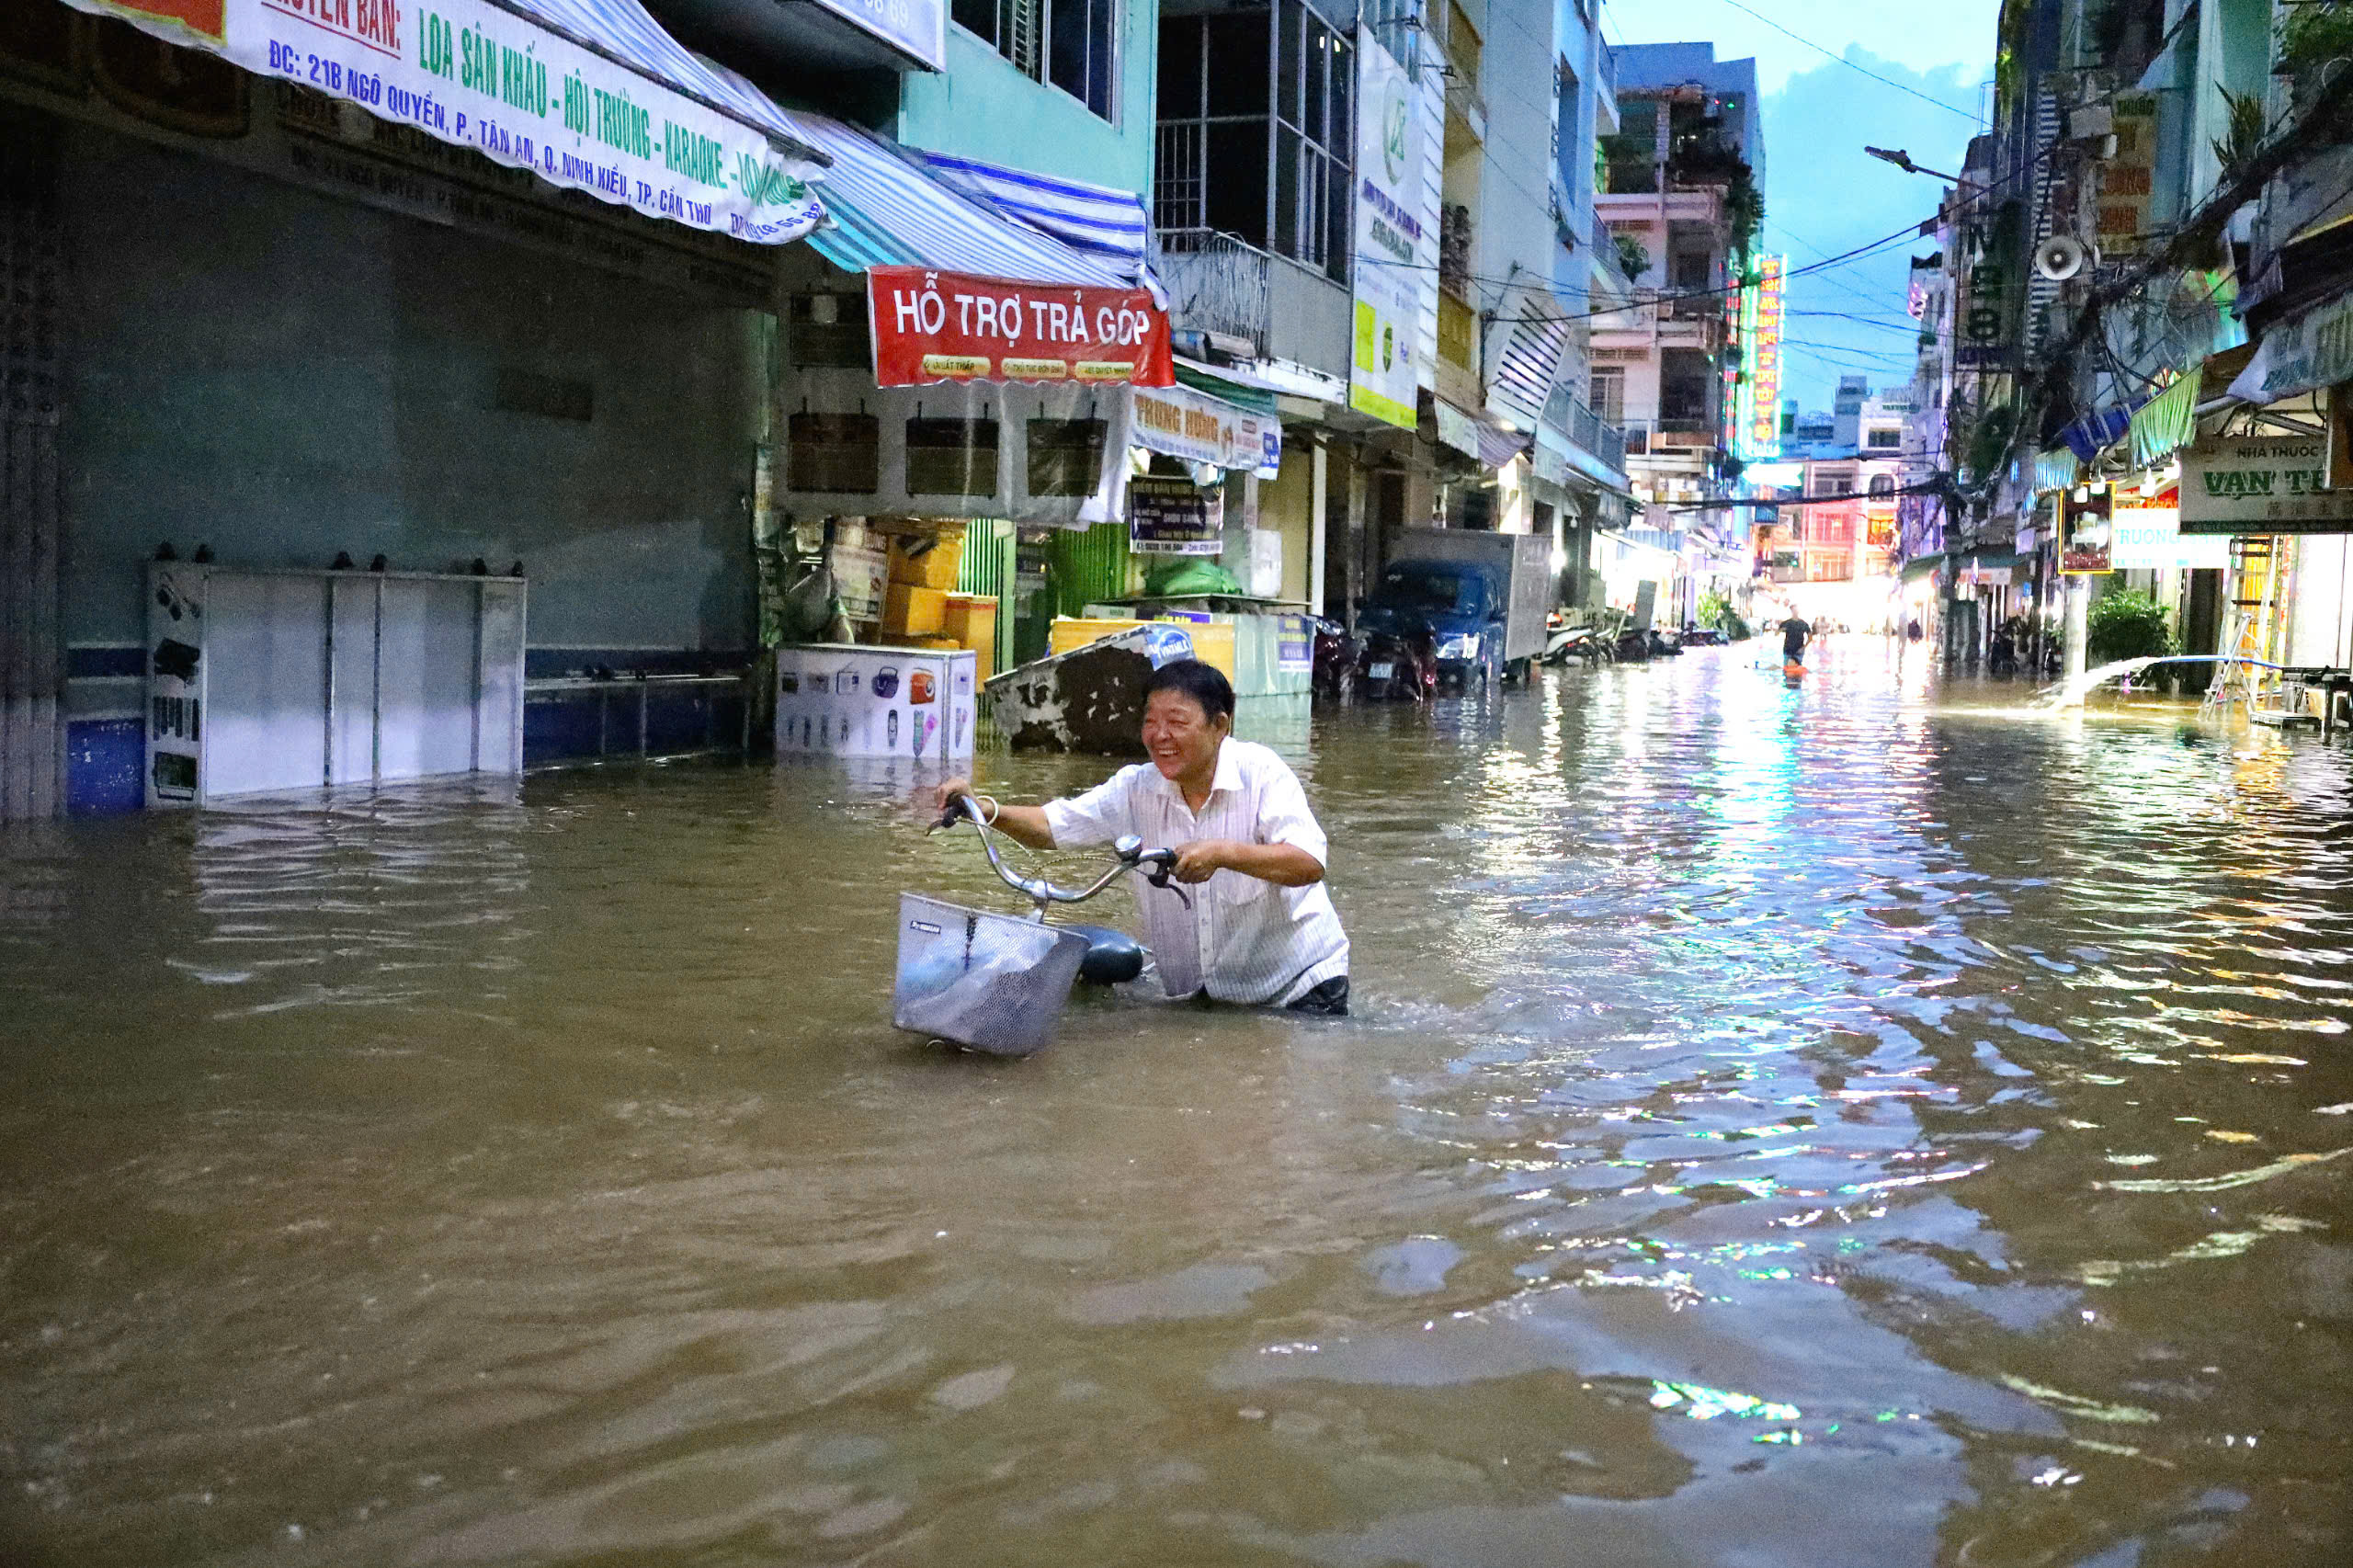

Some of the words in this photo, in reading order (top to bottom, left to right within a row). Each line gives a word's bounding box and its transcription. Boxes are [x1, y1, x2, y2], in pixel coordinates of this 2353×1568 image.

[269, 39, 301, 77] ĐC:
[308, 53, 342, 90] 21B
[347, 68, 381, 106] NGÔ
[456, 112, 472, 141] P.
[479, 119, 509, 154] TÂN
[515, 134, 539, 169] AN,
[544, 145, 558, 174] Q.
[563, 152, 593, 185] NINH
[636, 180, 655, 209] TP.
[659, 186, 683, 218] CẦN
[688, 200, 711, 225] THƠ
[775, 217, 804, 228] 55
[419, 7, 453, 81] LOA
[461, 21, 496, 98] SÂN
[503, 40, 547, 119] KHẤU
[564, 68, 589, 147] HỘI
[665, 119, 728, 189] KARAOKE
[893, 271, 946, 335] HỖ
[954, 293, 1023, 348] TRỢ
[1029, 290, 1090, 344] TRẢ
[1096, 299, 1150, 347] GÓP
